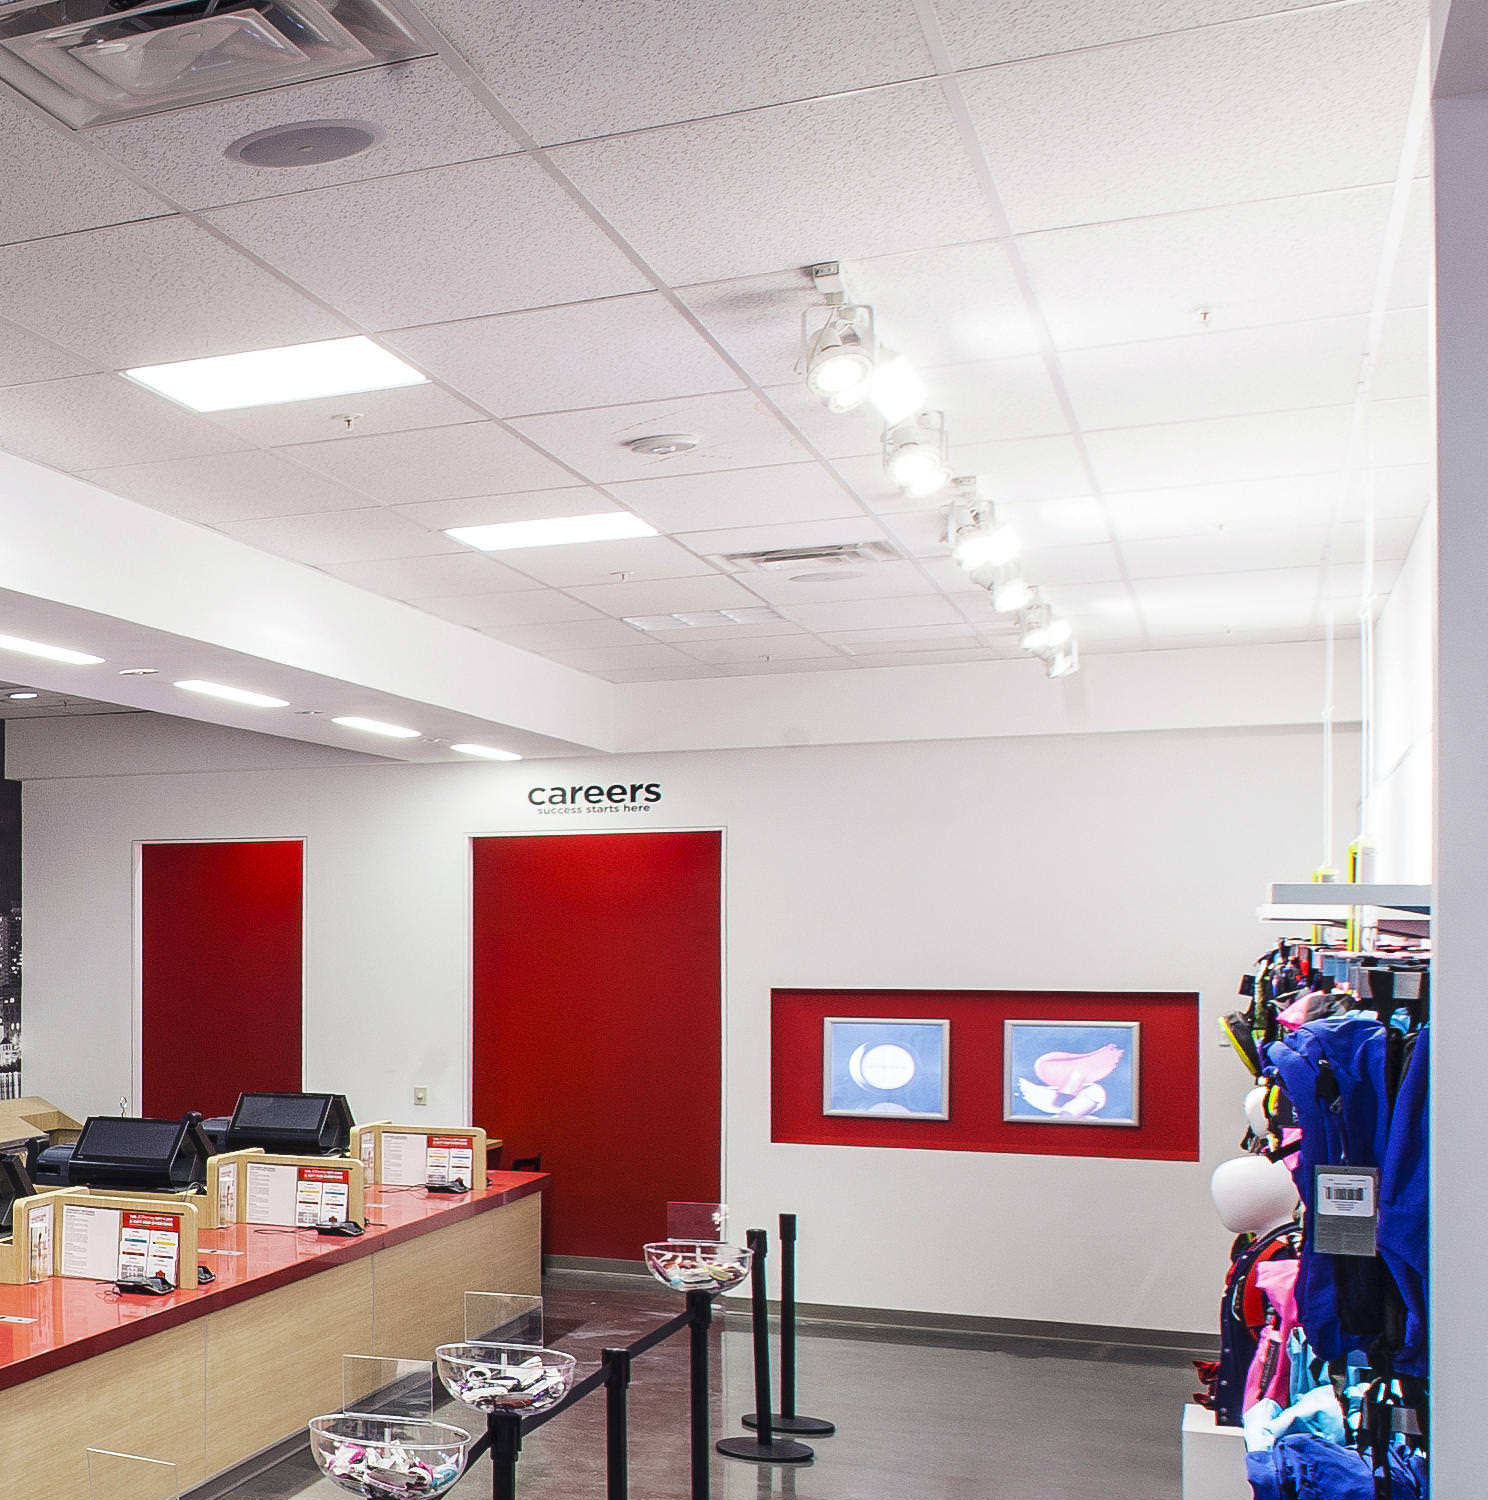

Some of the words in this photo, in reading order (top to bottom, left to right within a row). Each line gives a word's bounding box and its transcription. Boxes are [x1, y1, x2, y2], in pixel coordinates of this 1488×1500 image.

[528, 783, 662, 805] careers
[537, 806, 583, 815] success
[586, 805, 620, 814] starts
[624, 804, 651, 812] here
